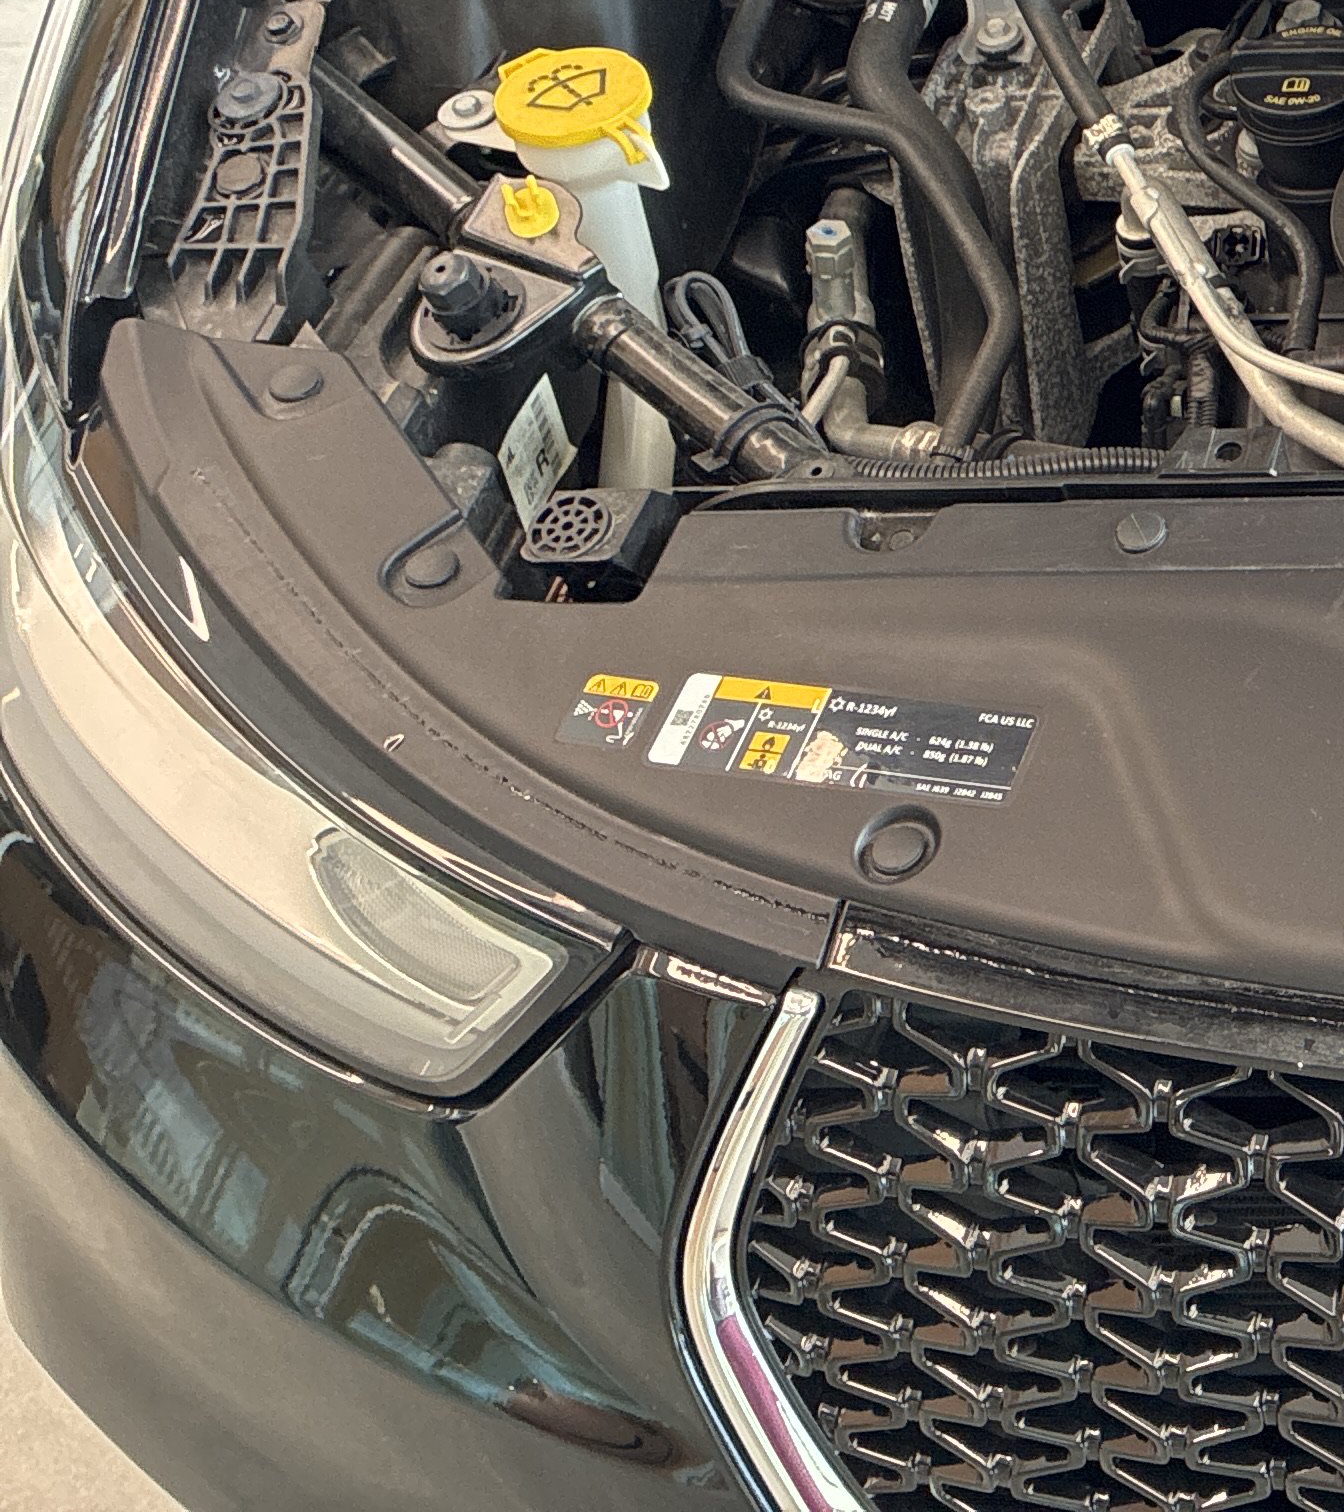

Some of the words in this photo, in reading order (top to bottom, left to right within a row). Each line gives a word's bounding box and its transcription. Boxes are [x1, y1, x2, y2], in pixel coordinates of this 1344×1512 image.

[1281, 26, 1325, 38] ENGINE
[1326, 27, 1343, 38] OIL
[1263, 94, 1287, 105] SAE
[1287, 93, 1321, 106] 0W-20
[845, 701, 898, 719] R-1234yf
[978, 713, 999, 724] FCA
[1000, 715, 1015, 726] US
[1015, 717, 1035, 729] LLC
[855, 726, 889, 739] SINGLE
[889, 730, 910, 742] A/C
[855, 740, 881, 753] DUAL
[881, 743, 904, 755] A/C
